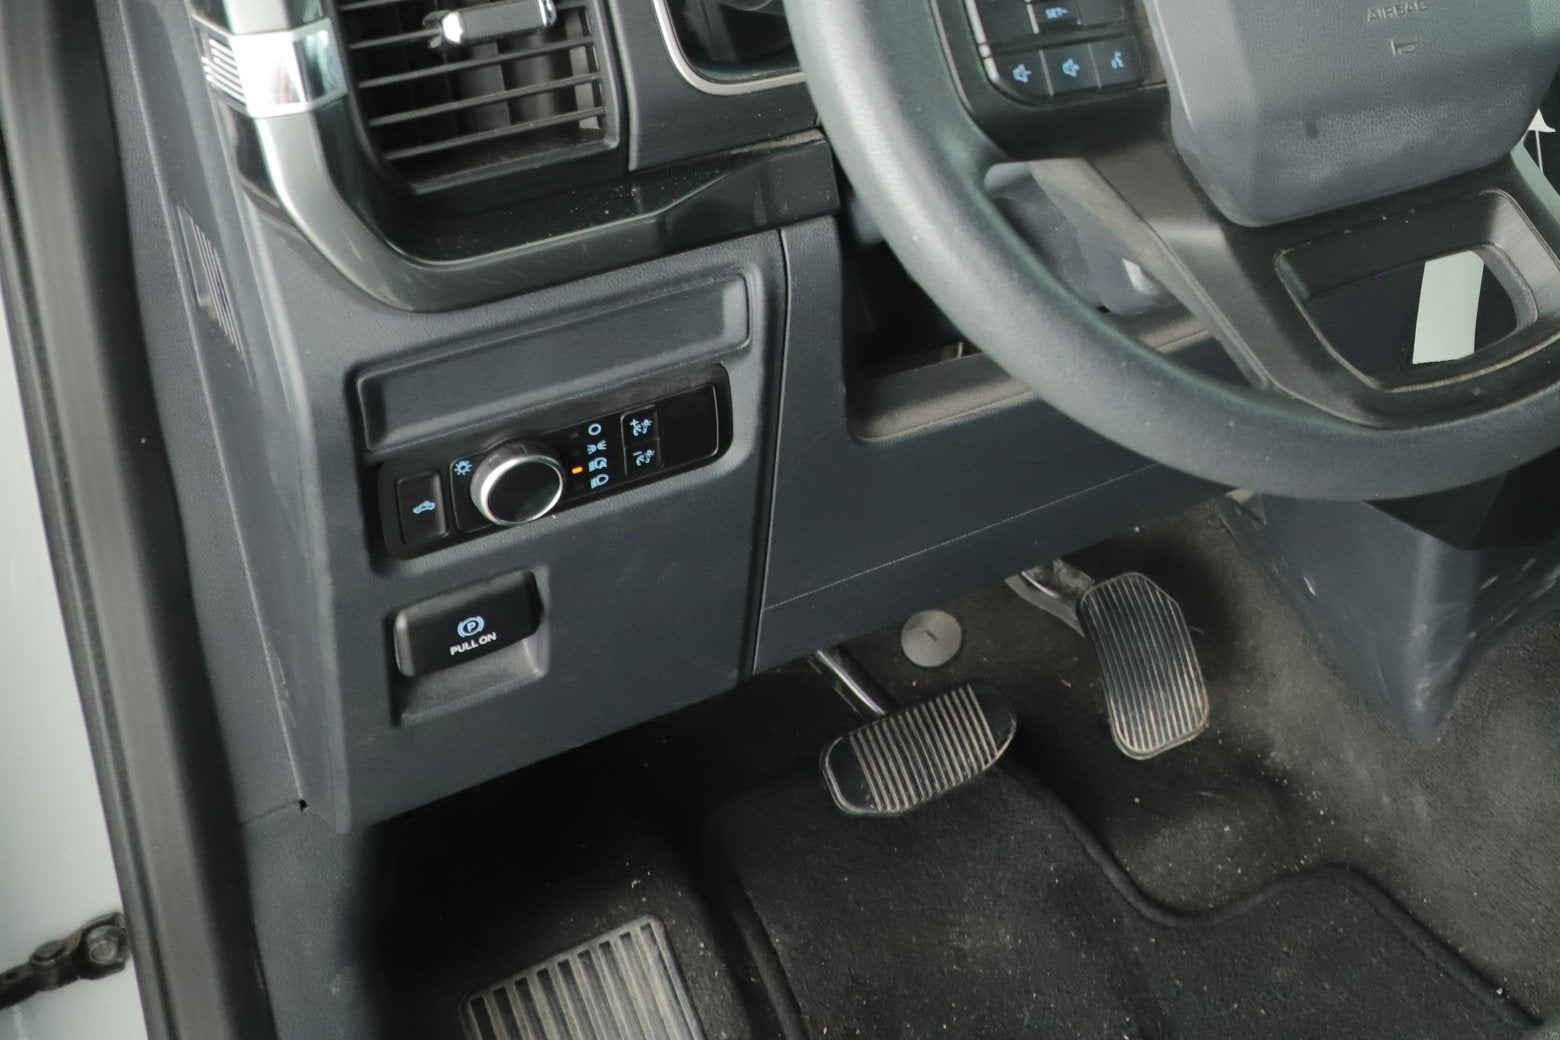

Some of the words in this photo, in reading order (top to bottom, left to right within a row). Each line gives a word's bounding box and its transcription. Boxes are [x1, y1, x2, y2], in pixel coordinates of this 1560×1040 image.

[1366, 0, 1428, 22] AIRBAG
[450, 640, 478, 655] PULL
[479, 632, 497, 644] ON
